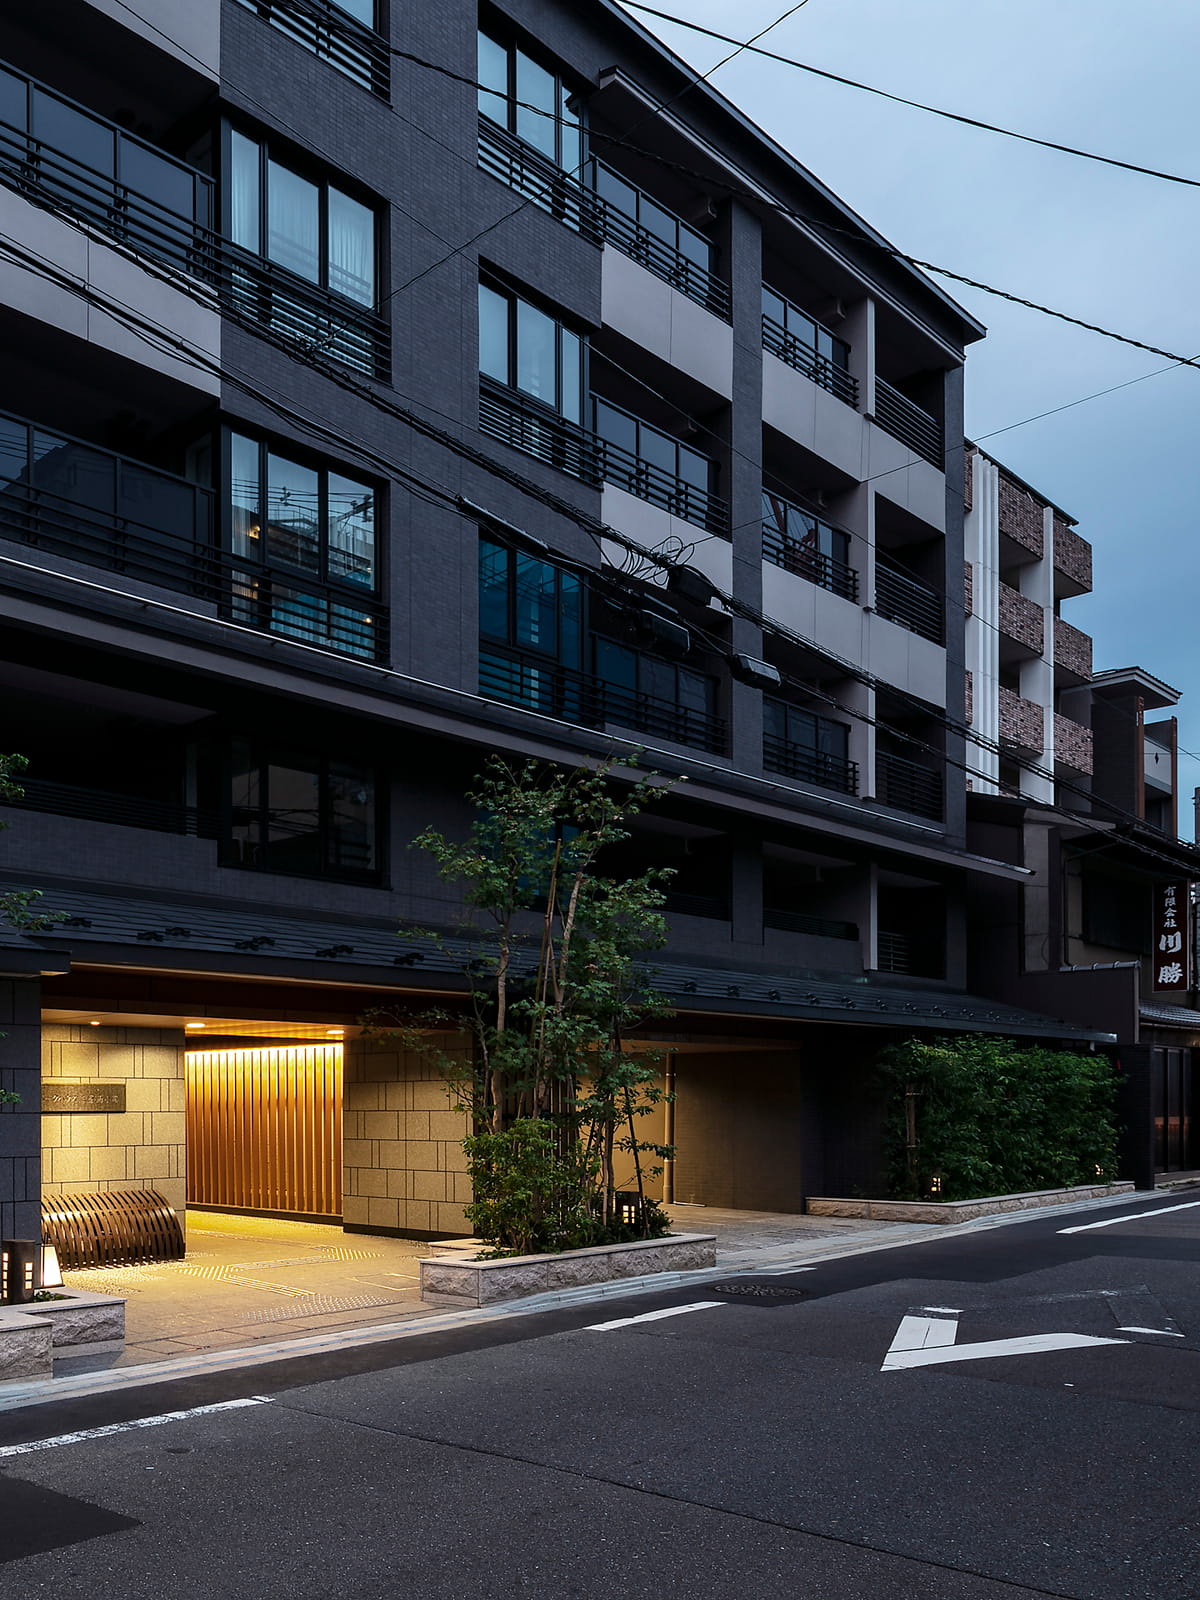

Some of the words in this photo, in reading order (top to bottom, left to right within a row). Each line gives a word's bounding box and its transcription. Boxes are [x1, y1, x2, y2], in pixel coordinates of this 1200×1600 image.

[1163, 885, 1178, 928] 有限会社
[1157, 931, 1184, 984] 川勝
